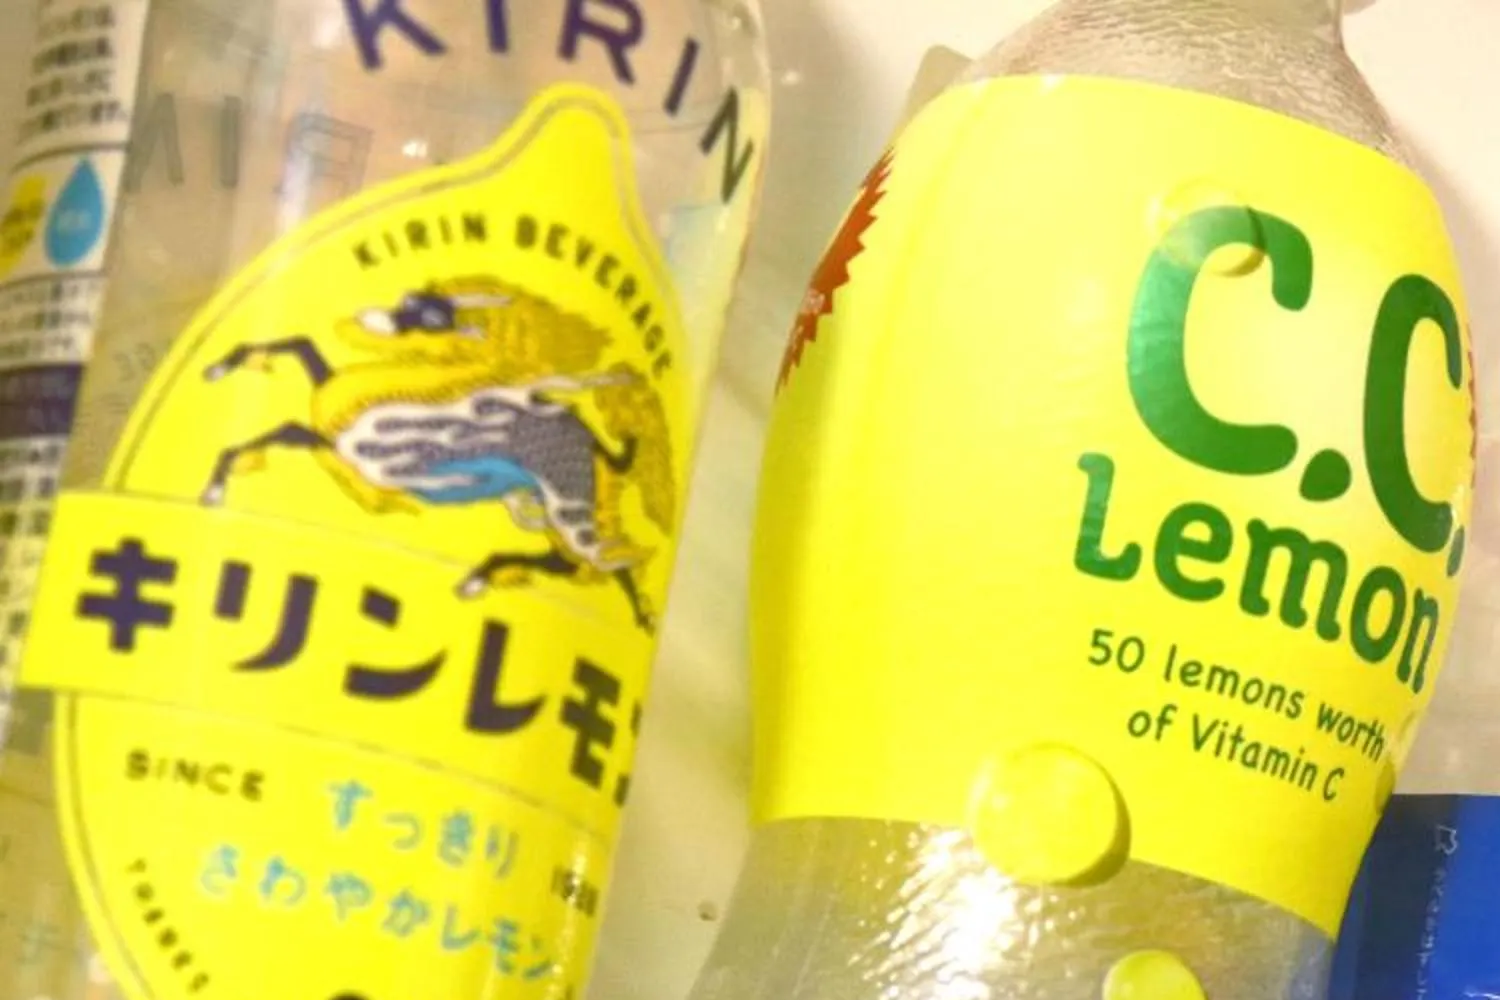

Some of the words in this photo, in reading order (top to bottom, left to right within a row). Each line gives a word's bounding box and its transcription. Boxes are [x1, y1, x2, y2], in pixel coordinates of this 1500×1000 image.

[343, 0, 755, 204] KIRIN
[352, 211, 488, 270] KIRIN
[513, 213, 672, 380] BEVERAGE
[1073, 451, 1441, 695] Lemon
[1088, 629, 1146, 674] 50
[1163, 644, 1304, 719] lemons
[1315, 699, 1387, 763] worth
[1127, 703, 1179, 741] of
[1190, 712, 1318, 799] Vitamin
[1322, 767, 1346, 803] C
[125, 747, 266, 803] SINCE
